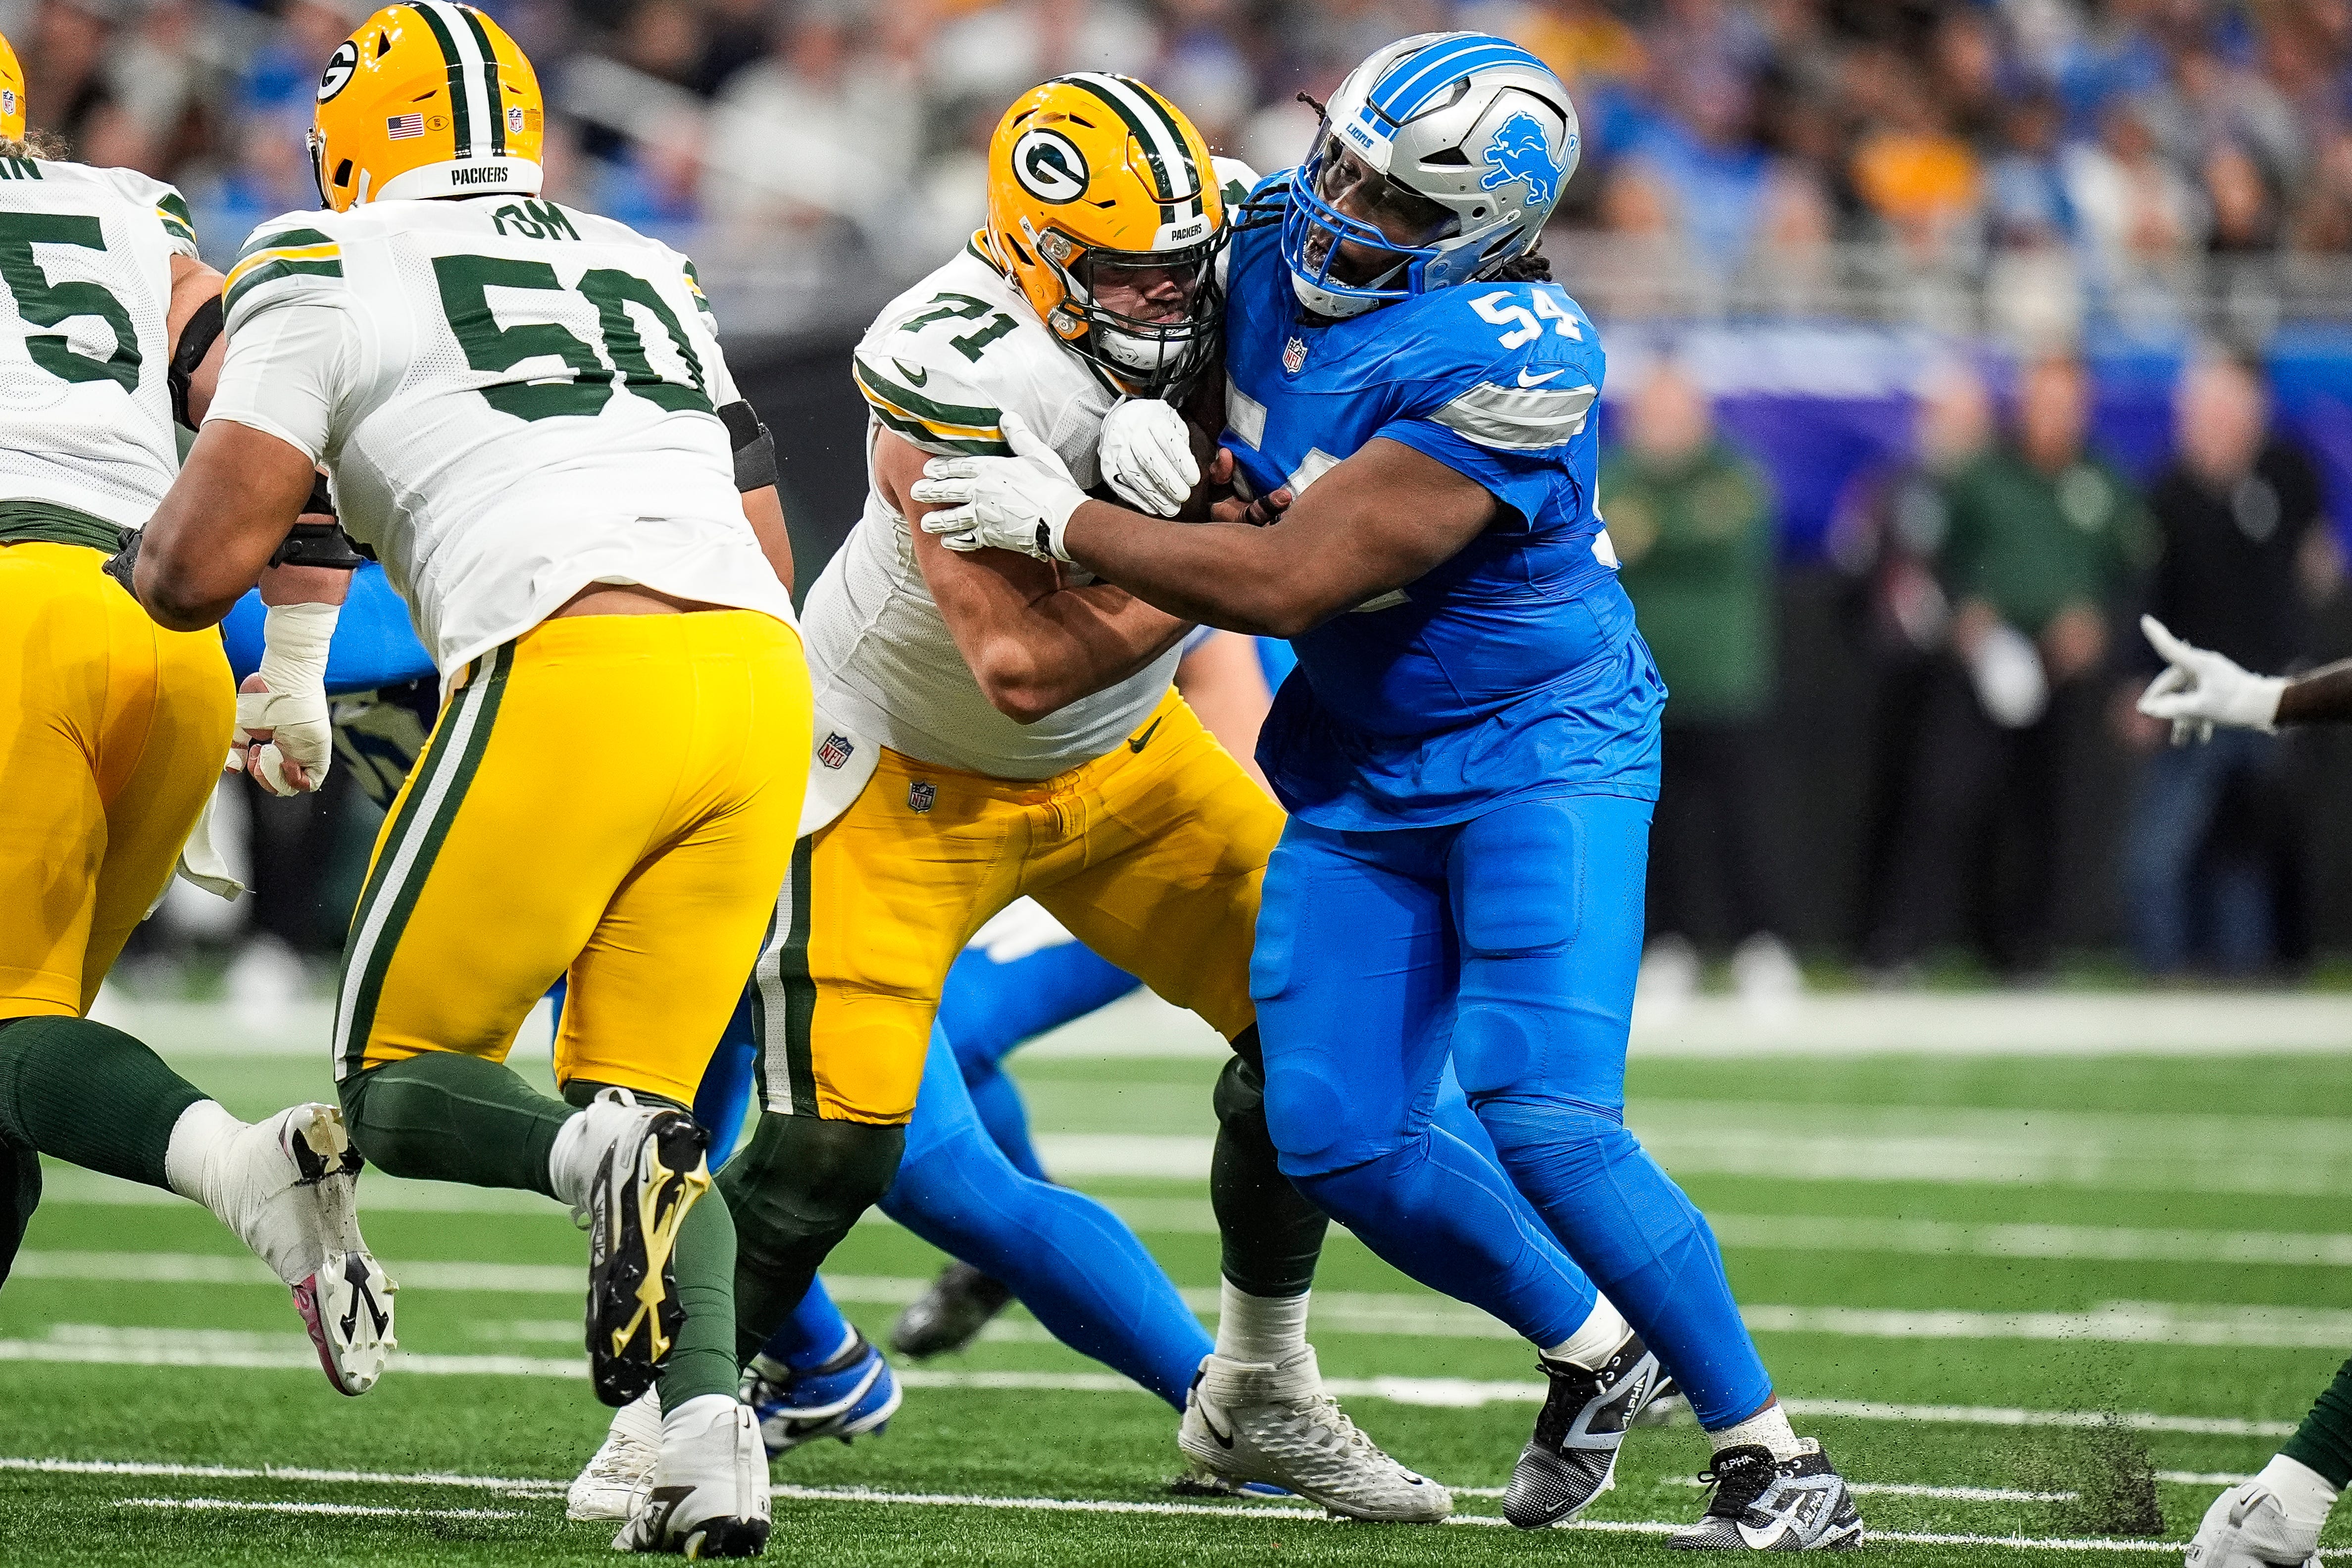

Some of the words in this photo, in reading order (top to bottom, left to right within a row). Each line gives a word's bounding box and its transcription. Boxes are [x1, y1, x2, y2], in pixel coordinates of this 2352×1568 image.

[4, 100, 13, 111] NFL
[510, 118, 523, 129] NFL
[1346, 122, 1374, 149] LIONS
[451, 167, 508, 186] PACKERS
[1171, 223, 1202, 242] PACKERS
[899, 292, 1020, 363] 71
[1468, 289, 1583, 350] 54
[432, 254, 717, 422] 50
[1285, 350, 1299, 368] NFL
[819, 743, 845, 767] NFL
[912, 793, 933, 809] NFL
[1622, 1375, 1647, 1430] ALPHA
[1719, 1455, 1756, 1471] ALPHA
[1803, 1490, 1827, 1528] ALPHA
